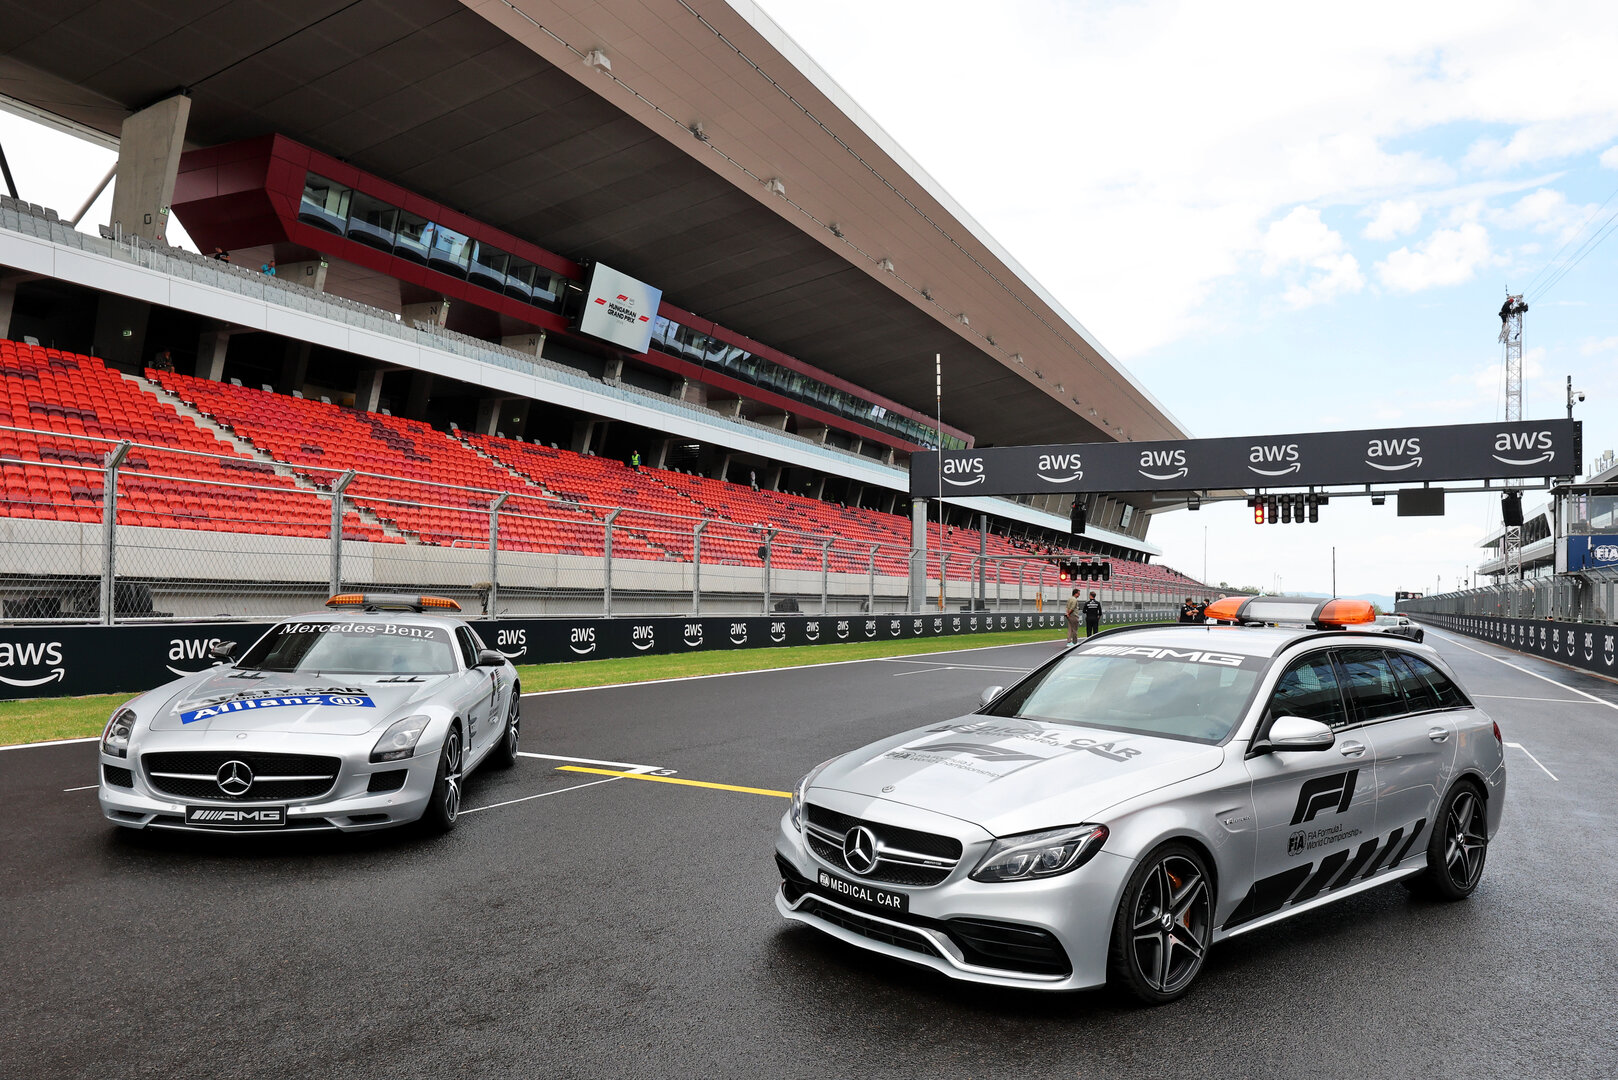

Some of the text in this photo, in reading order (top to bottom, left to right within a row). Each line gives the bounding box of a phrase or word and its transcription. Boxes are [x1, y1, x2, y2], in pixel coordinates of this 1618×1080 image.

[430, 306, 438, 316] N
[607, 309, 624, 320] GRAND
[624, 315, 635, 324] PRIX
[608, 303, 637, 318] HUNGARIAN
[528, 338, 536, 346] N
[1367, 437, 1422, 458] aws
[1494, 430, 1553, 451] aws
[1139, 449, 1187, 468] aws
[1249, 443, 1299, 463] aws
[943, 457, 984, 475] aws
[1038, 453, 1082, 471] aws
[278, 622, 435, 639] Mercedes-Benz
[684, 623, 703, 637] aws
[730, 622, 747, 635] aws
[770, 621, 786, 634] aws
[806, 621, 820, 632] aws
[837, 620, 849, 631] aws
[865, 619, 877, 630] aws
[890, 619, 901, 630] aws
[913, 618, 923, 628] aws
[497, 629, 526, 645] aws
[570, 627, 596, 642] aws
[632, 625, 654, 639] aws
[0, 641, 63, 666] aws
[193, 697, 323, 720] Allianz
[1070, 738, 1143, 759] CAR
[1289, 768, 1360, 826] F1
[1307, 828, 1359, 850] World Championship
[1308, 831, 1318, 841] FIA
[1318, 825, 1339, 838] Formula
[1287, 834, 1305, 853] FIA
[830, 877, 901, 909] MEDICAL CAR
